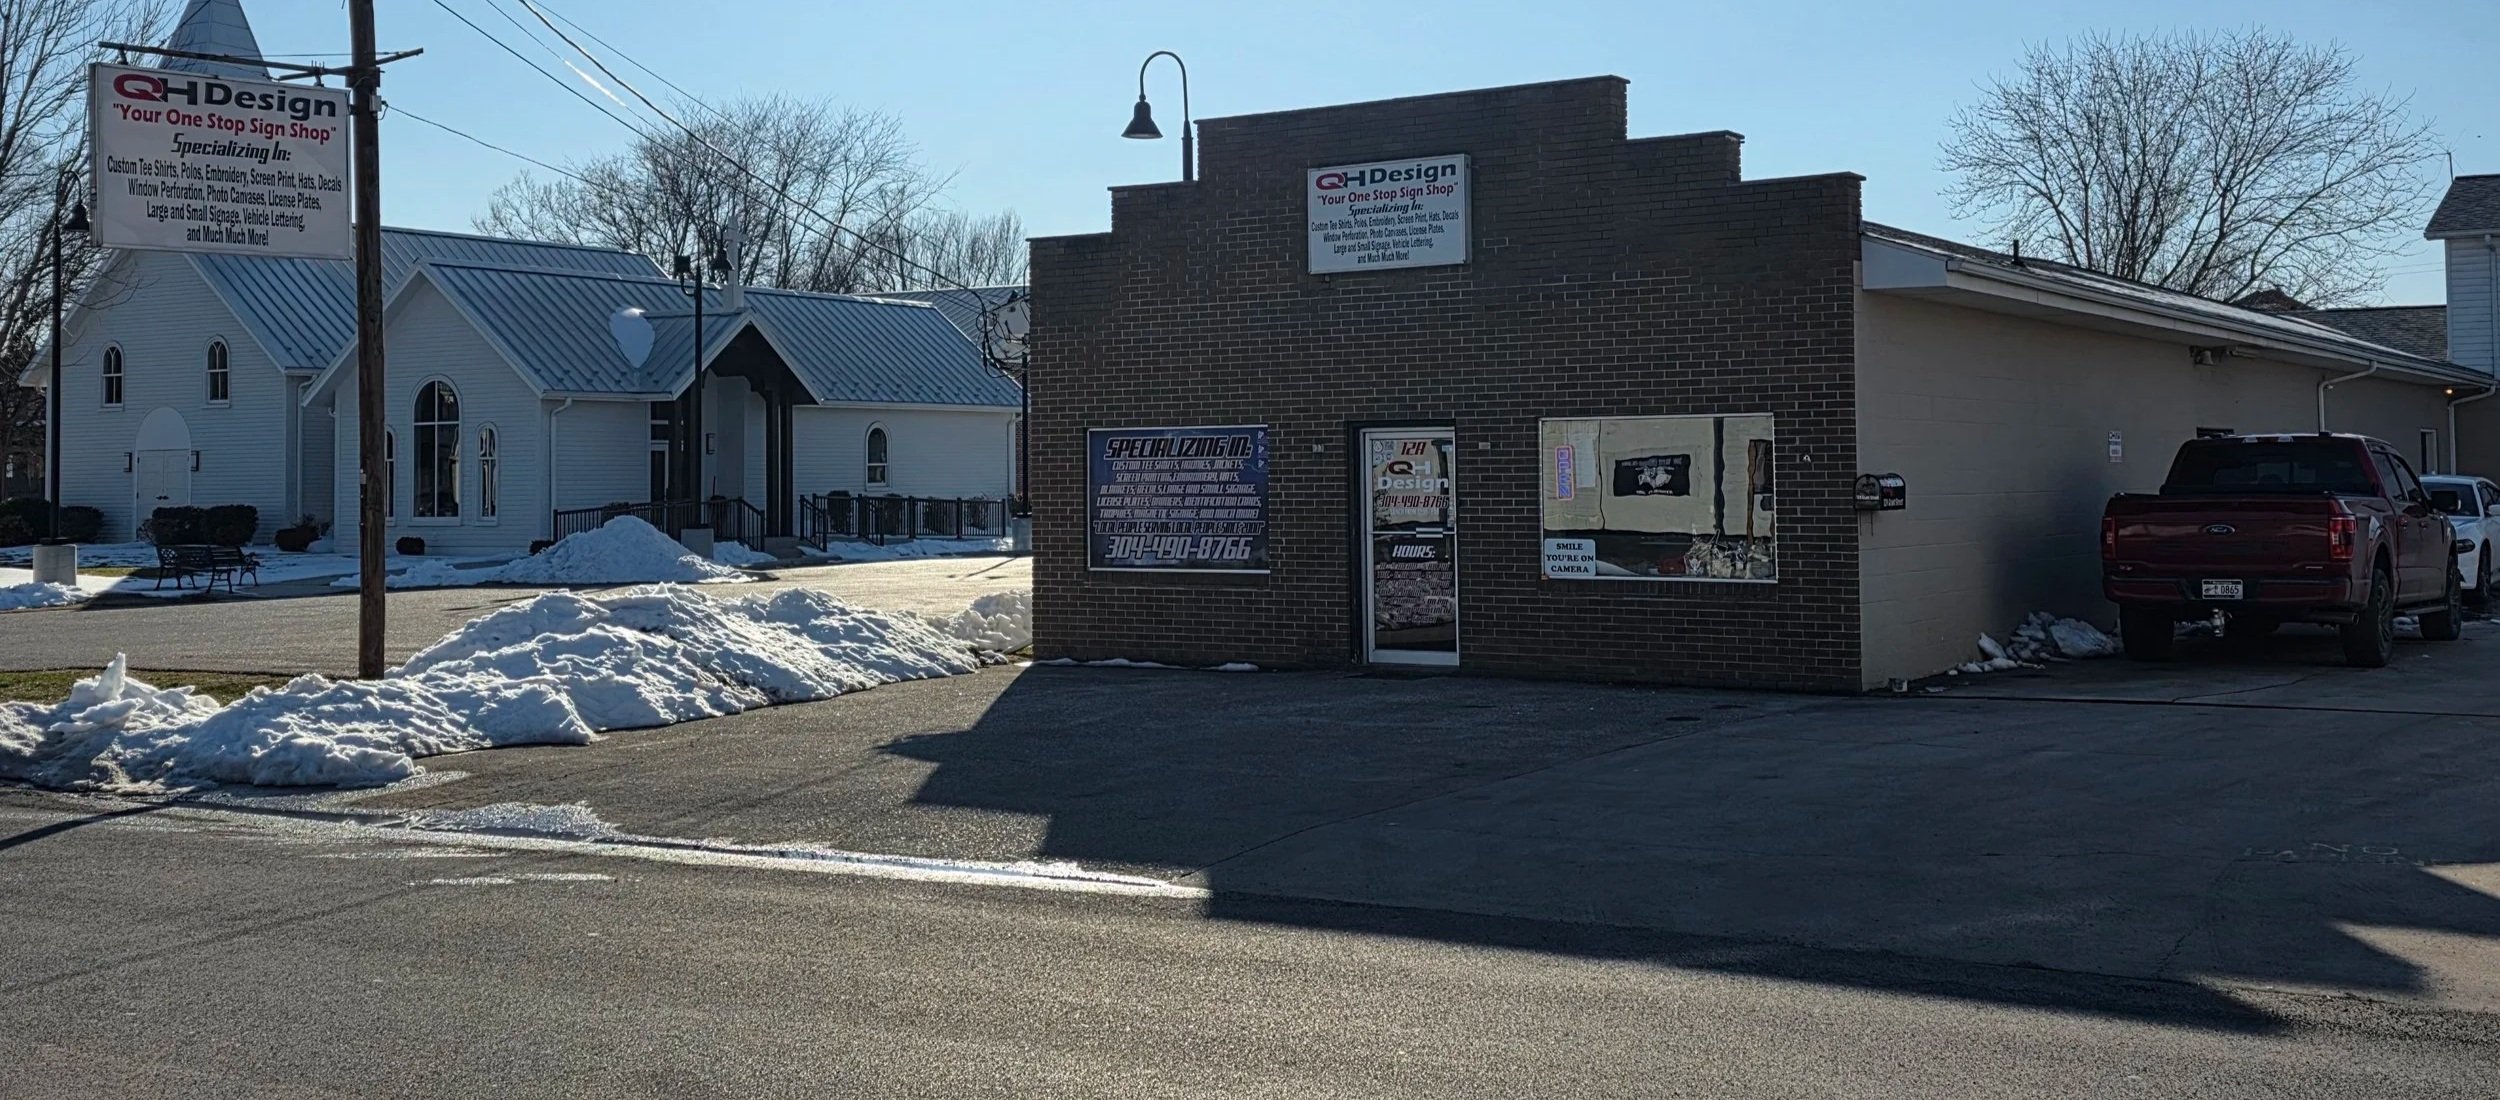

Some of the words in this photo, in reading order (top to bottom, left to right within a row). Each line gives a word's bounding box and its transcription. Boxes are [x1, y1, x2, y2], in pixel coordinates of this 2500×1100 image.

[113, 103, 161, 123] "Your
[167, 109, 202, 127] One
[207, 113, 245, 135] Stop
[250, 118, 285, 139] Sign
[290, 123, 336, 144] Shop"
[171, 133, 270, 164] Specializing
[272, 141, 291, 161] In:
[108, 156, 137, 175] Custom
[139, 159, 152, 176] Tee
[154, 160, 179, 179] Shirts,
[181, 163, 203, 183] Polos,
[206, 164, 249, 187] Embroidery,
[251, 169, 275, 186] Screen
[278, 171, 296, 189] Print,
[299, 173, 317, 191] Hats,
[319, 174, 342, 192] Decals
[128, 178, 158, 197] Window
[161, 181, 205, 201] Perforation,
[207, 184, 228, 202] Photo
[230, 186, 267, 206] Canvases,
[268, 189, 296, 207] License
[297, 190, 322, 210] Plates,
[1317, 193, 1345, 205] "Your
[1348, 189, 1370, 203] One
[1373, 188, 1397, 202] Stop
[1400, 186, 1423, 199] Sign
[1426, 181, 1458, 196] Shop"
[147, 201, 168, 223] Large
[171, 204, 185, 220] and
[186, 204, 207, 222] Small
[209, 206, 241, 228] Signage,
[243, 208, 269, 226] Vehicle
[271, 210, 305, 232] Lettering,
[1348, 201, 1409, 217] Specializing
[1411, 200, 1423, 211] In:
[1312, 221, 1328, 232] Custom
[1329, 221, 1337, 230] Tee
[1354, 218, 1368, 228] Polos,
[1369, 215, 1396, 228] Embroidery,
[1398, 214, 1413, 224] Screen
[1415, 212, 1428, 223] Print,
[1429, 211, 1441, 222] Hats,
[1442, 210, 1459, 220] Decals
[187, 226, 200, 241] and
[202, 226, 223, 243] Much
[225, 227, 246, 244] Much
[248, 229, 268, 246] More!
[1323, 231, 1341, 242] Window
[1370, 229, 1383, 239] Photo
[1385, 227, 1408, 238] Canvases,
[1409, 225, 1427, 236] License
[1334, 243, 1346, 255] Large
[1348, 242, 1356, 252] and
[1358, 241, 1370, 251] Small
[1372, 240, 1391, 254] Signage,
[1393, 239, 1410, 249] Vehicle
[1411, 238, 1433, 249] Lettering,
[1358, 254, 1366, 263] and
[1367, 252, 1380, 263] Much
[1381, 252, 1394, 262] Much
[1395, 251, 1409, 261] More!
[1104, 436, 1226, 460] SPECIALIZING
[1226, 436, 1252, 459] IN:
[1112, 460, 1140, 470] CUSTOM
[1142, 460, 1154, 470] TEE
[1389, 461, 1431, 475] QH
[1378, 476, 1448, 493] Design
[1380, 496, 1449, 508] 304-490-8766
[1105, 536, 1253, 560] 304-490-8766
[1392, 545, 1436, 558] HOURS:
[1546, 554, 1578, 562] YOU'RE
[1581, 554, 1594, 562] ON
[1551, 565, 1589, 573] CAMERA
